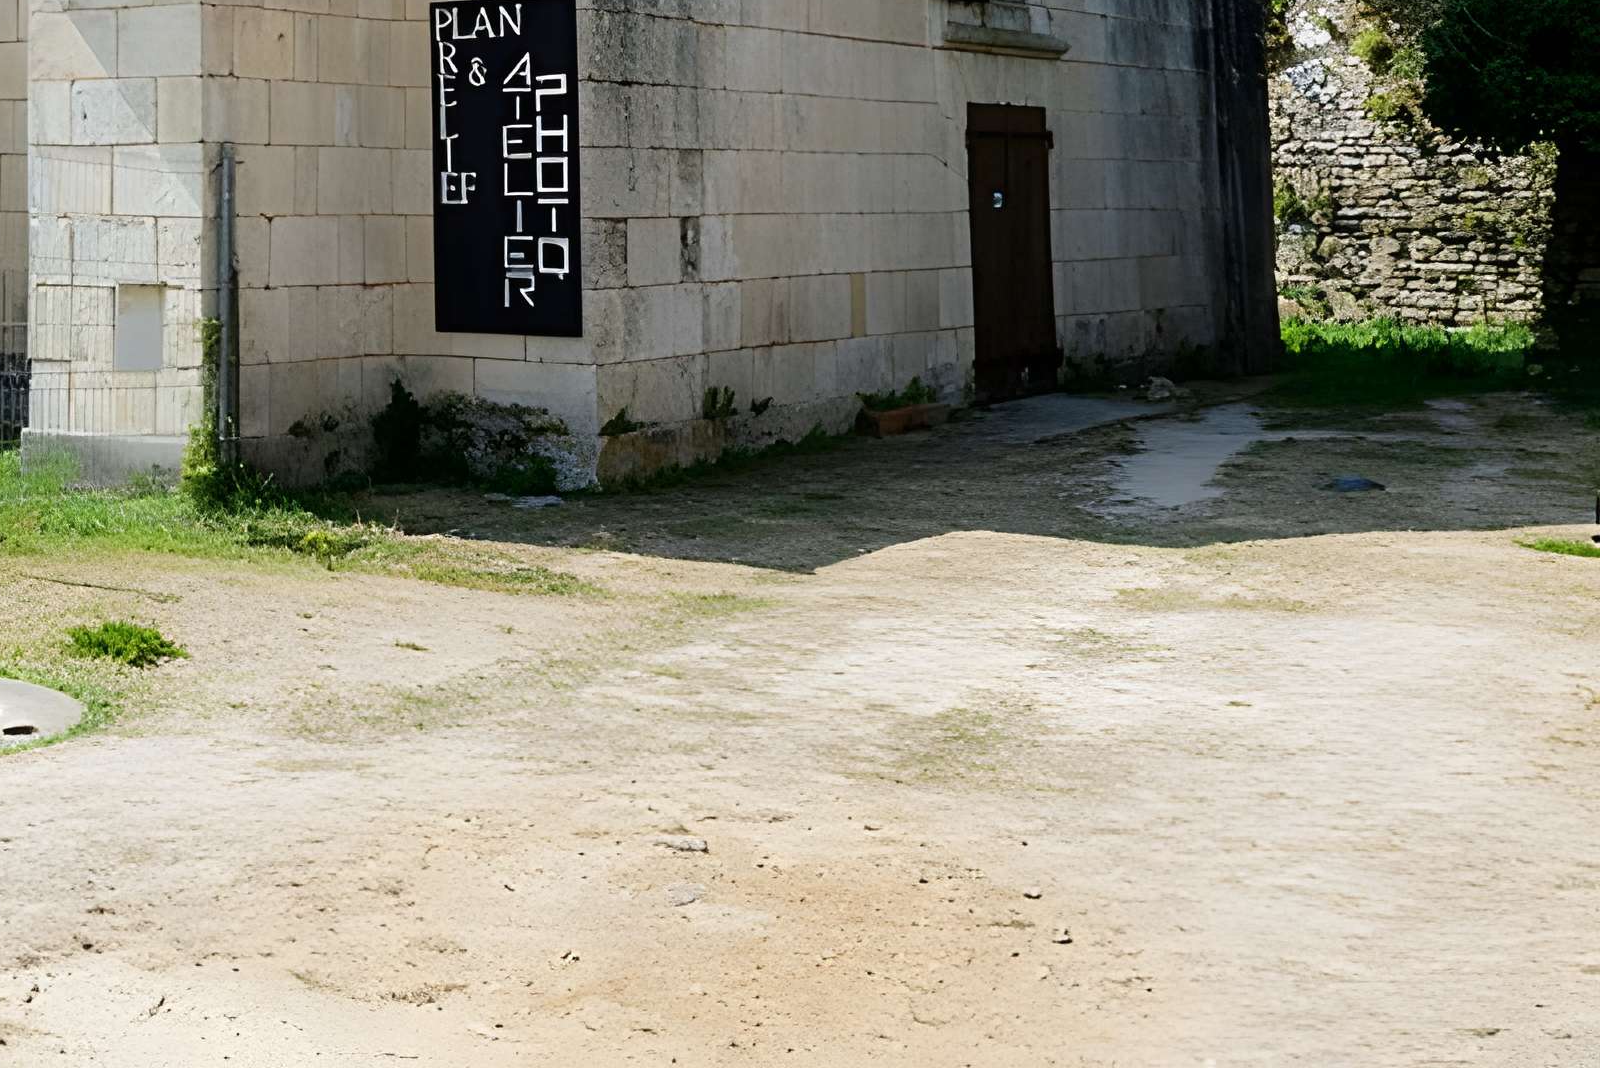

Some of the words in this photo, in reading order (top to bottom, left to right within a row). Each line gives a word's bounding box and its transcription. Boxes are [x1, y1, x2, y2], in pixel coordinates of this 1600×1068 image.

[435, 3, 522, 42] PLAN
[468, 56, 488, 87] &
[502, 51, 535, 308] ATELIER
